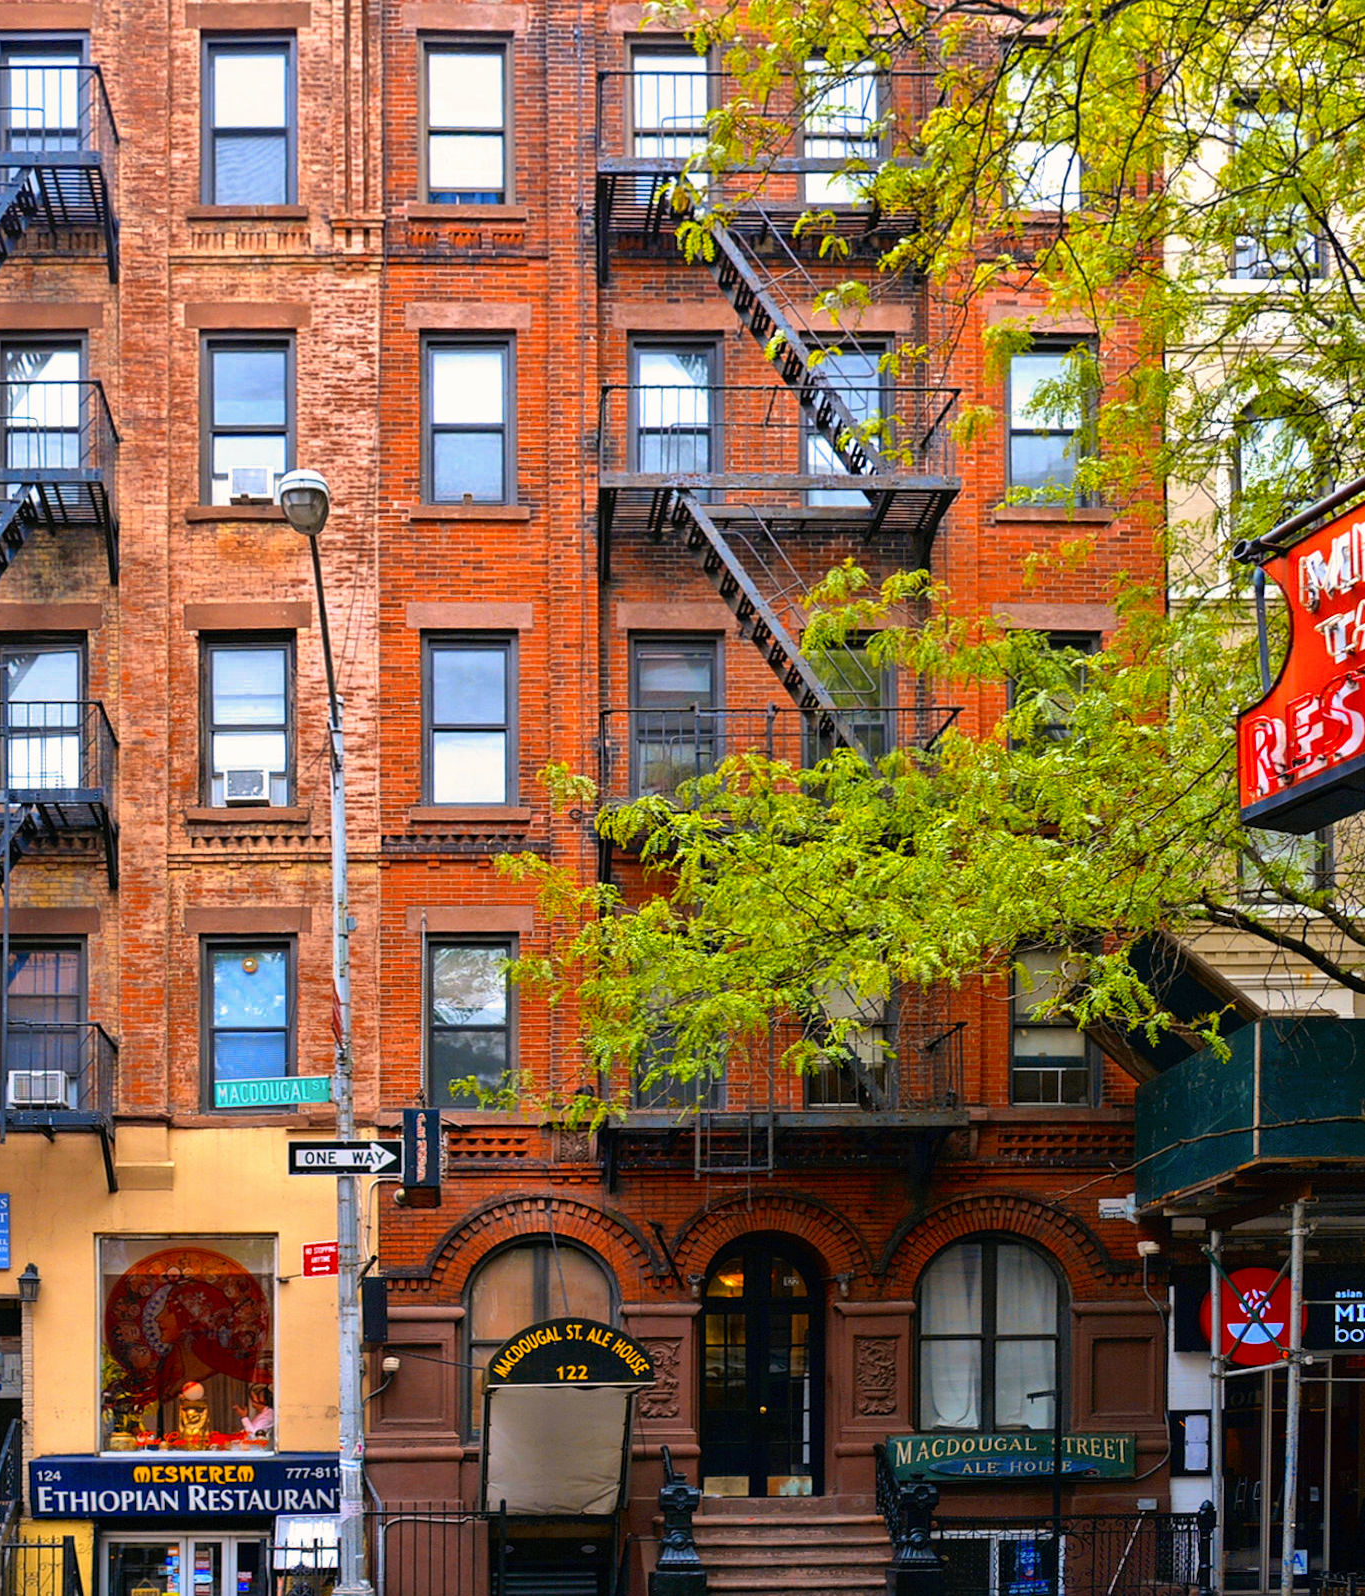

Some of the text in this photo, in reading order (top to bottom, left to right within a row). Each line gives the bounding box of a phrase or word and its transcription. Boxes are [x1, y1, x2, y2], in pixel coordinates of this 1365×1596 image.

[216, 1080, 327, 1104] MACDOUGAL ST
[305, 1152, 385, 1164] ONE WAY
[1335, 1289, 1363, 1298] asian
[1335, 1325, 1365, 1342] bo
[493, 1324, 650, 1378] MACDOUGAL ST. ALE HOUSE
[556, 1365, 589, 1380] 122
[895, 1436, 1038, 1468] MACDOUGAL
[35, 1471, 62, 1482] 124
[133, 1465, 255, 1485] MESKEREM
[962, 1461, 999, 1474] ALE
[37, 1486, 180, 1513] ETHIOPIAN
